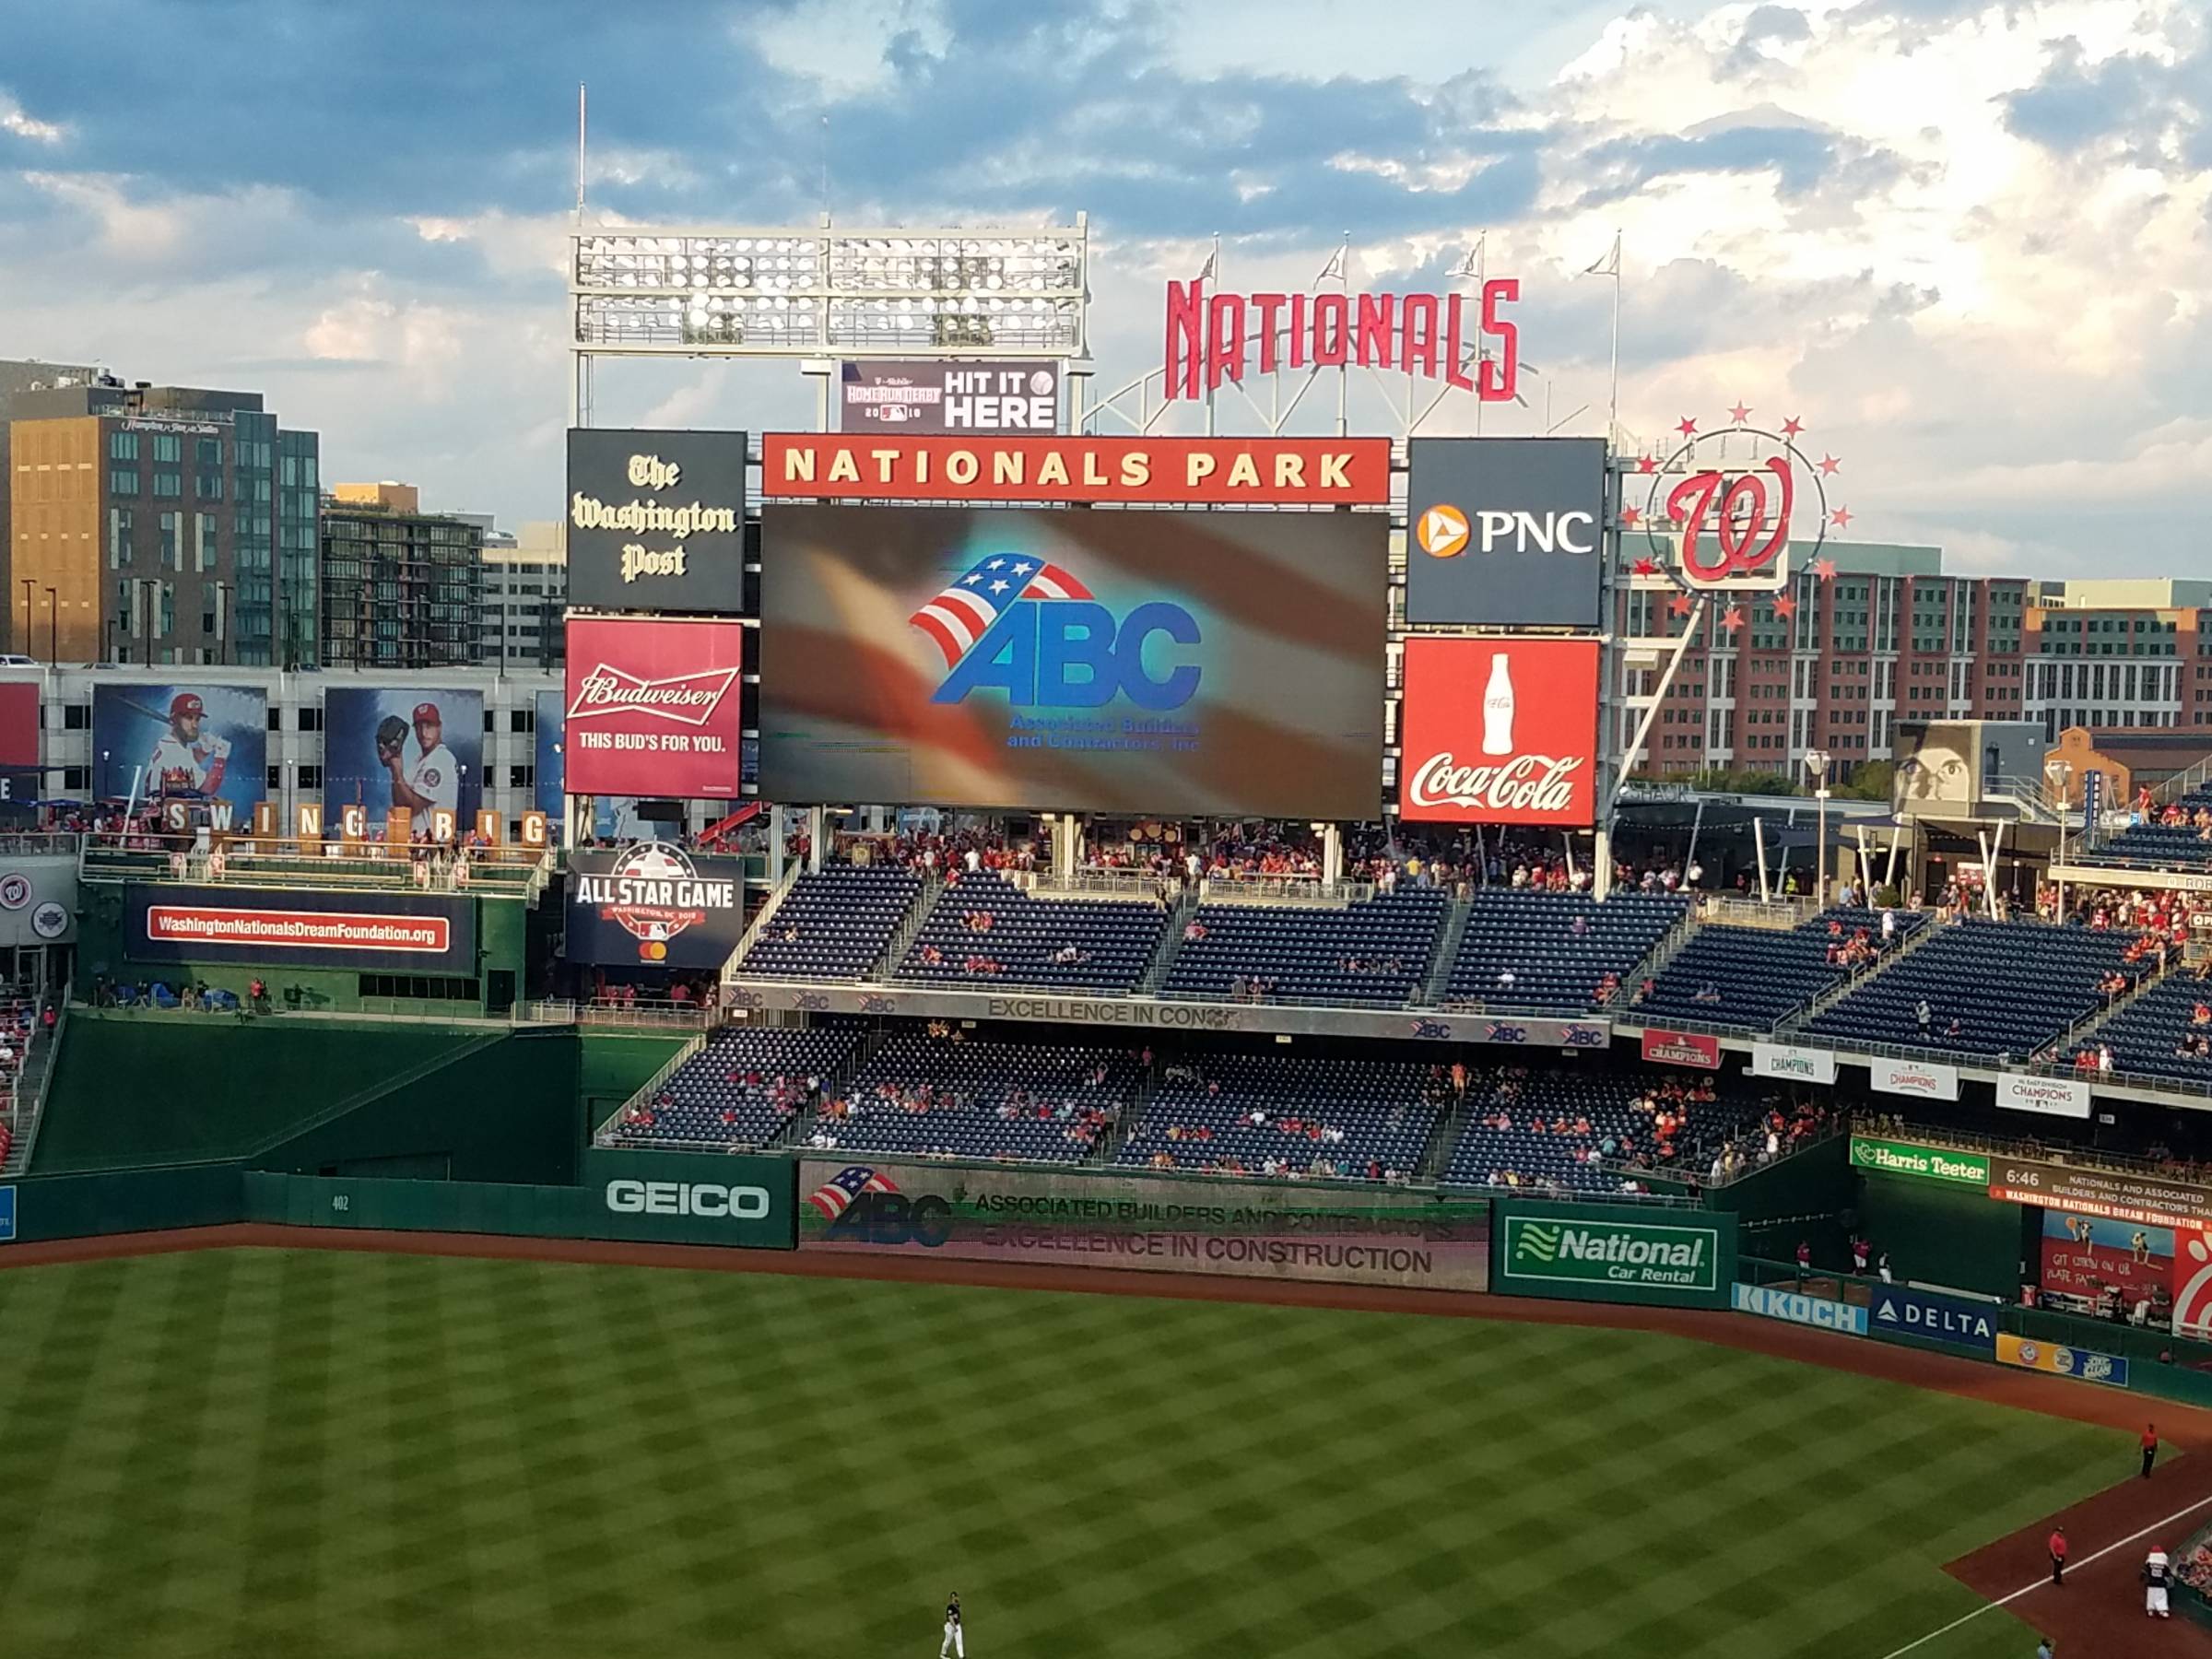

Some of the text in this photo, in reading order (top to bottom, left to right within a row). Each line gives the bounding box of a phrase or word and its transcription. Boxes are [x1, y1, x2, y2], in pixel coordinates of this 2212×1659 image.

[1165, 278, 1519, 402] NATIONALS
[847, 385, 942, 404] HOME RUN DERBY
[945, 371, 1026, 394] HIT IT
[945, 396, 1055, 429] HERE
[629, 454, 680, 490] The
[785, 448, 1353, 488] NATIONALS PARK
[572, 491, 737, 538] Washington
[1477, 511, 1594, 553] PNC
[621, 544, 686, 582] Post
[929, 602, 1202, 711] ABC
[582, 676, 719, 705] Budweiser
[580, 733, 726, 752] THIS BUD'S FOR YOU.
[1007, 735, 1041, 747] and
[1410, 752, 1584, 810] Coca-Cola
[576, 877, 734, 908] ALL STAR GAME
[159, 916, 435, 944] WashingtonNationalsDreamFoundation.org
[729, 992, 763, 1006] ABC
[795, 995, 830, 1010] ABC
[860, 998, 895, 1013] ABC
[989, 999, 1127, 1022] EXCELLENCE
[1134, 1006, 1152, 1023] IN
[1413, 1024, 1451, 1039] ABC
[1488, 1028, 1526, 1042] ABC
[1563, 1030, 1603, 1045] ABC
[1649, 1048, 1712, 1064] CHAMPIONS
[1771, 1057, 1815, 1077] CHAMPIONS
[1889, 1073, 1936, 1090] CHAMPIONS
[2012, 1085, 2073, 1102] CHAMPIONS
[1875, 1148, 1984, 1180] Harris Teeter
[2006, 1169, 2039, 1186] 6:46
[332, 1194, 348, 1211] 402
[606, 1180, 770, 1219] GEICO
[2006, 1189, 2060, 1206] WASHINGTON
[2063, 1198, 2111, 1216] NATIONALS
[2053, 1184, 2095, 1199] BUILDERS
[2099, 1192, 2118, 1203] AND
[2120, 1194, 2188, 1215] CONTRACTORS
[2069, 1175, 2204, 1204] NATIONALS AND ASSOCIATED
[821, 1193, 951, 1247] ABC
[975, 1194, 1112, 1218] ASSOCIATED
[1118, 1202, 1225, 1224] BUILDERS
[1171, 1235, 1197, 1257] IN
[1206, 1238, 1431, 1273] CONSTRUCTION
[1559, 1230, 1699, 1267] National
[1608, 1265, 1695, 1283] Car Rental
[1905, 1304, 1991, 1338] DELTA
